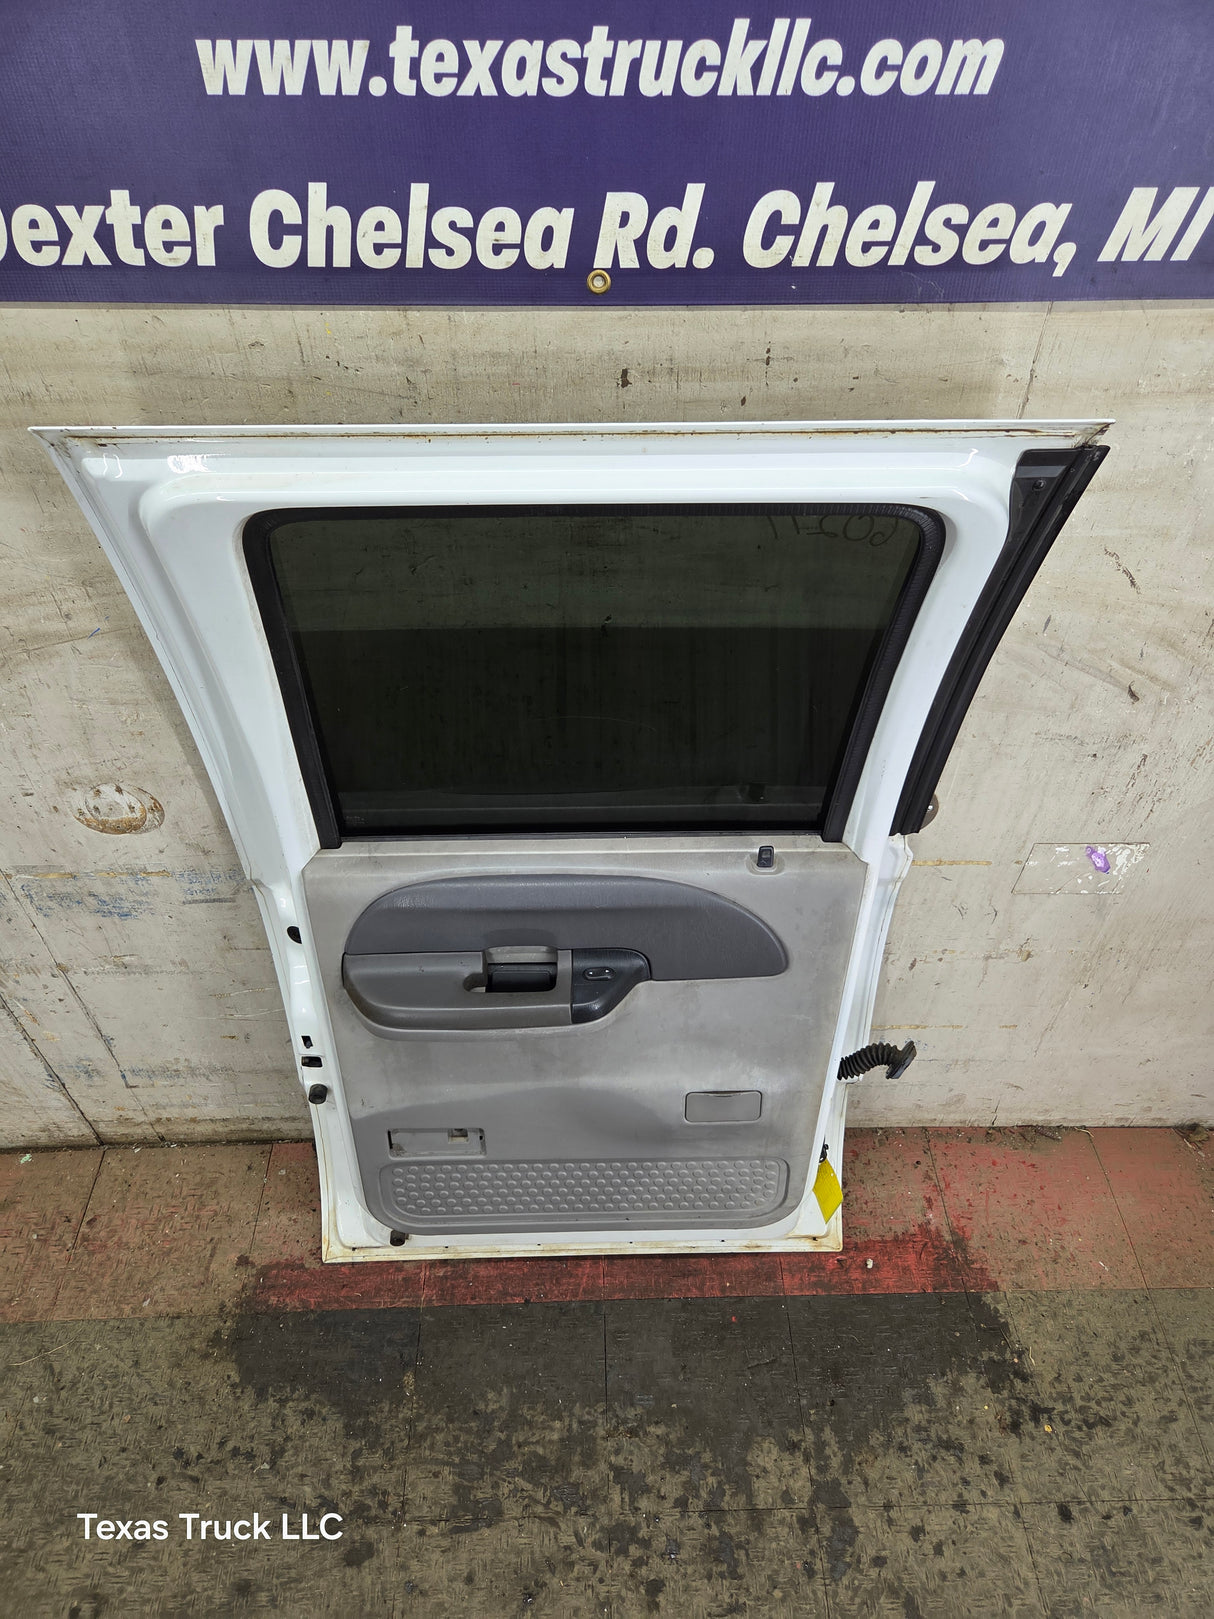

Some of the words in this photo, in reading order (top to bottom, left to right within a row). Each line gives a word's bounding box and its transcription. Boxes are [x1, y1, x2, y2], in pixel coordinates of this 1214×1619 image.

[195, 18, 1005, 97] www.texastruckllc.com
[0, 189, 224, 267] exter
[249, 182, 575, 269] Chelsea
[593, 183, 715, 269] Rd.
[743, 181, 1077, 278] Chelsea,
[1096, 186, 1214, 262] MI
